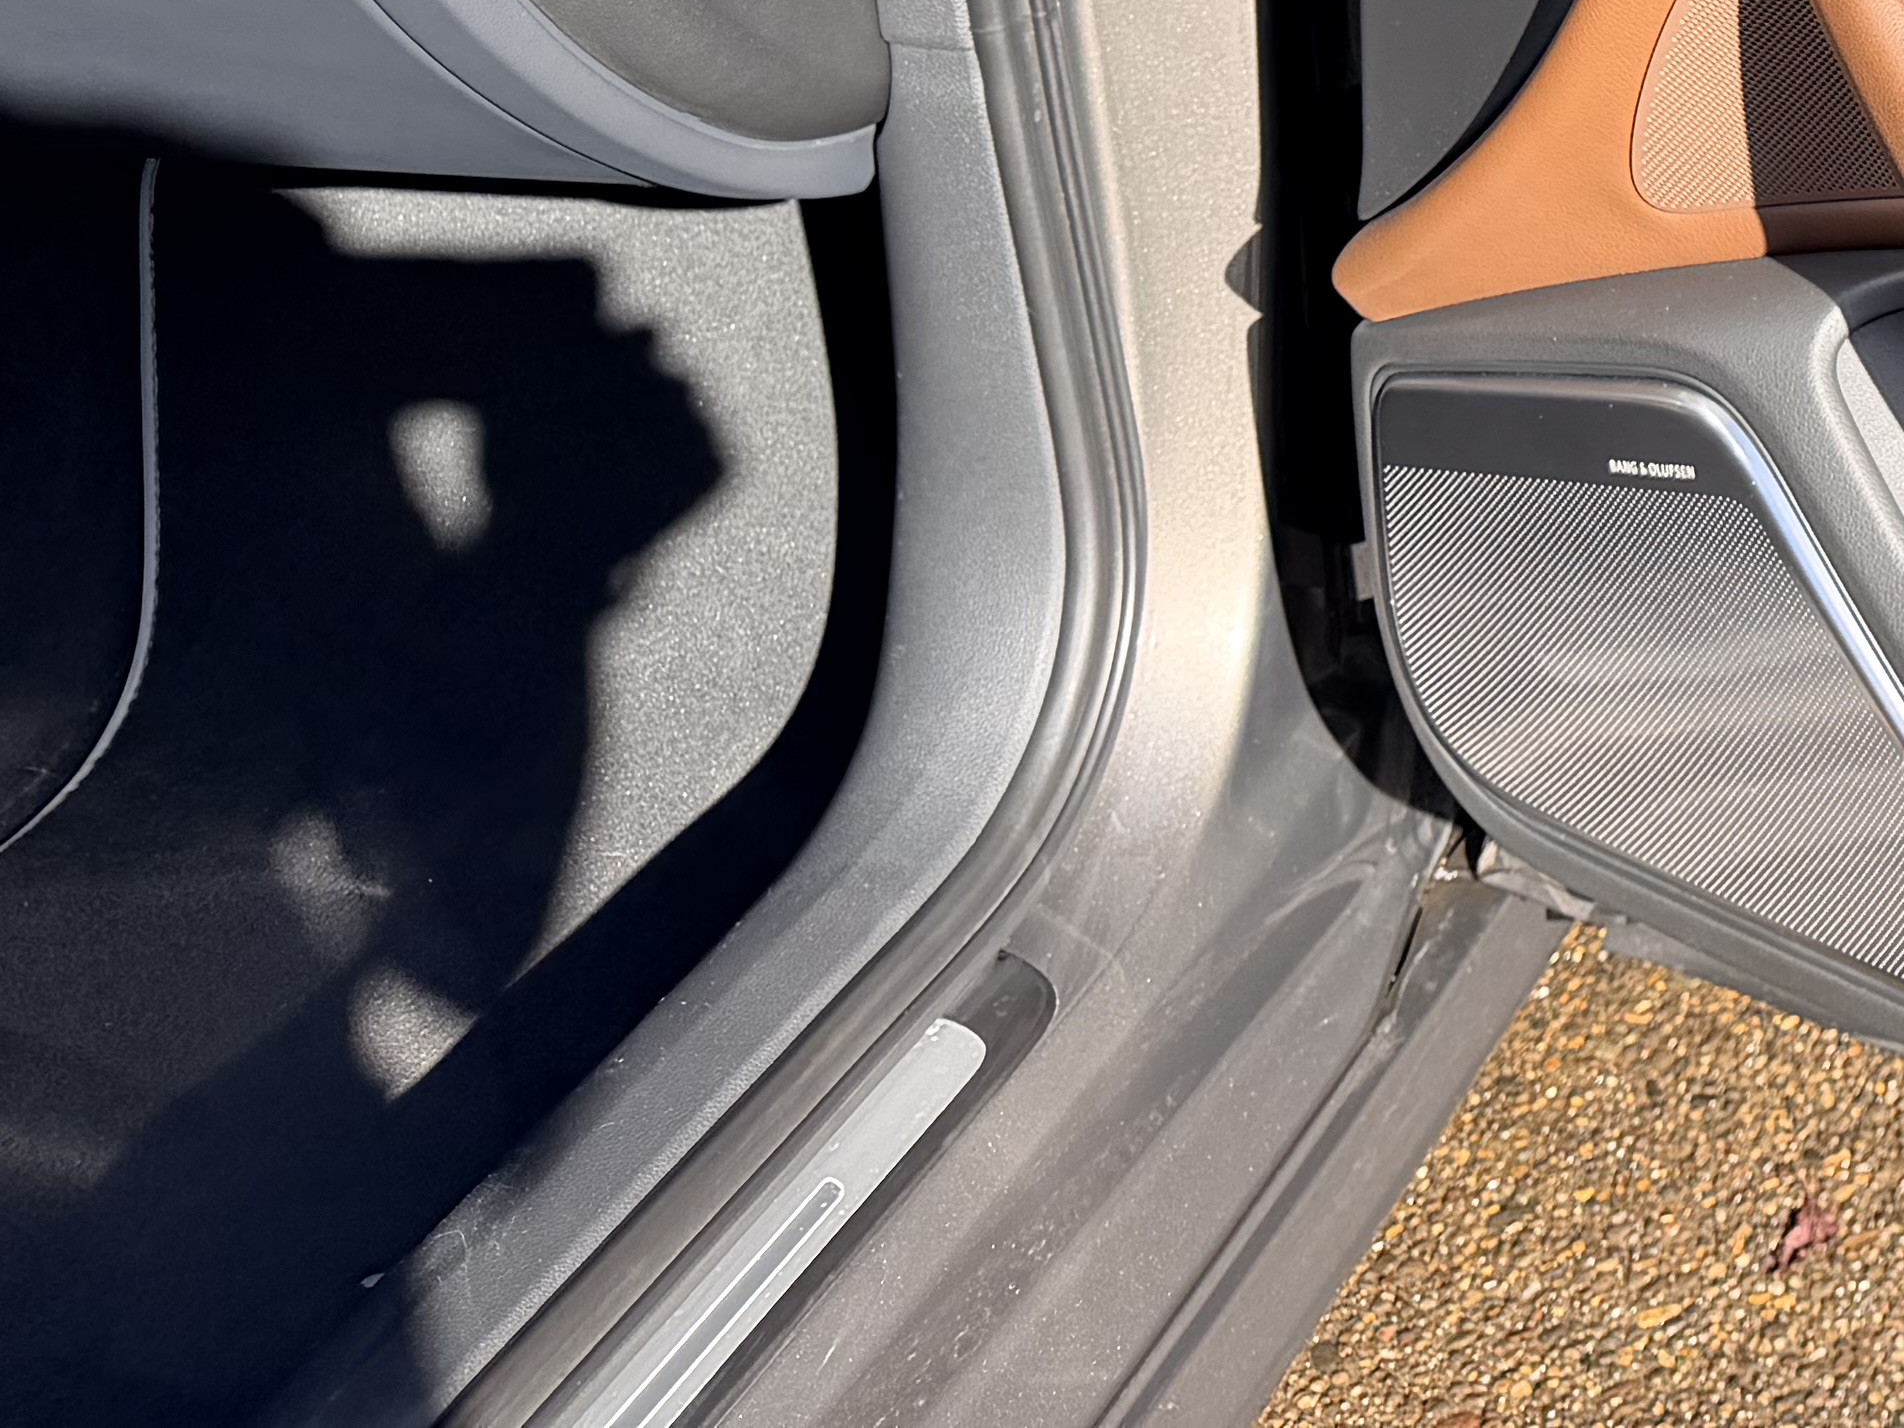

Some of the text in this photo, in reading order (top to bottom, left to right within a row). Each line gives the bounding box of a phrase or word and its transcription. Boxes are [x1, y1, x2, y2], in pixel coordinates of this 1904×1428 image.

[1608, 458, 1696, 481] BANG & OLUFSEN
